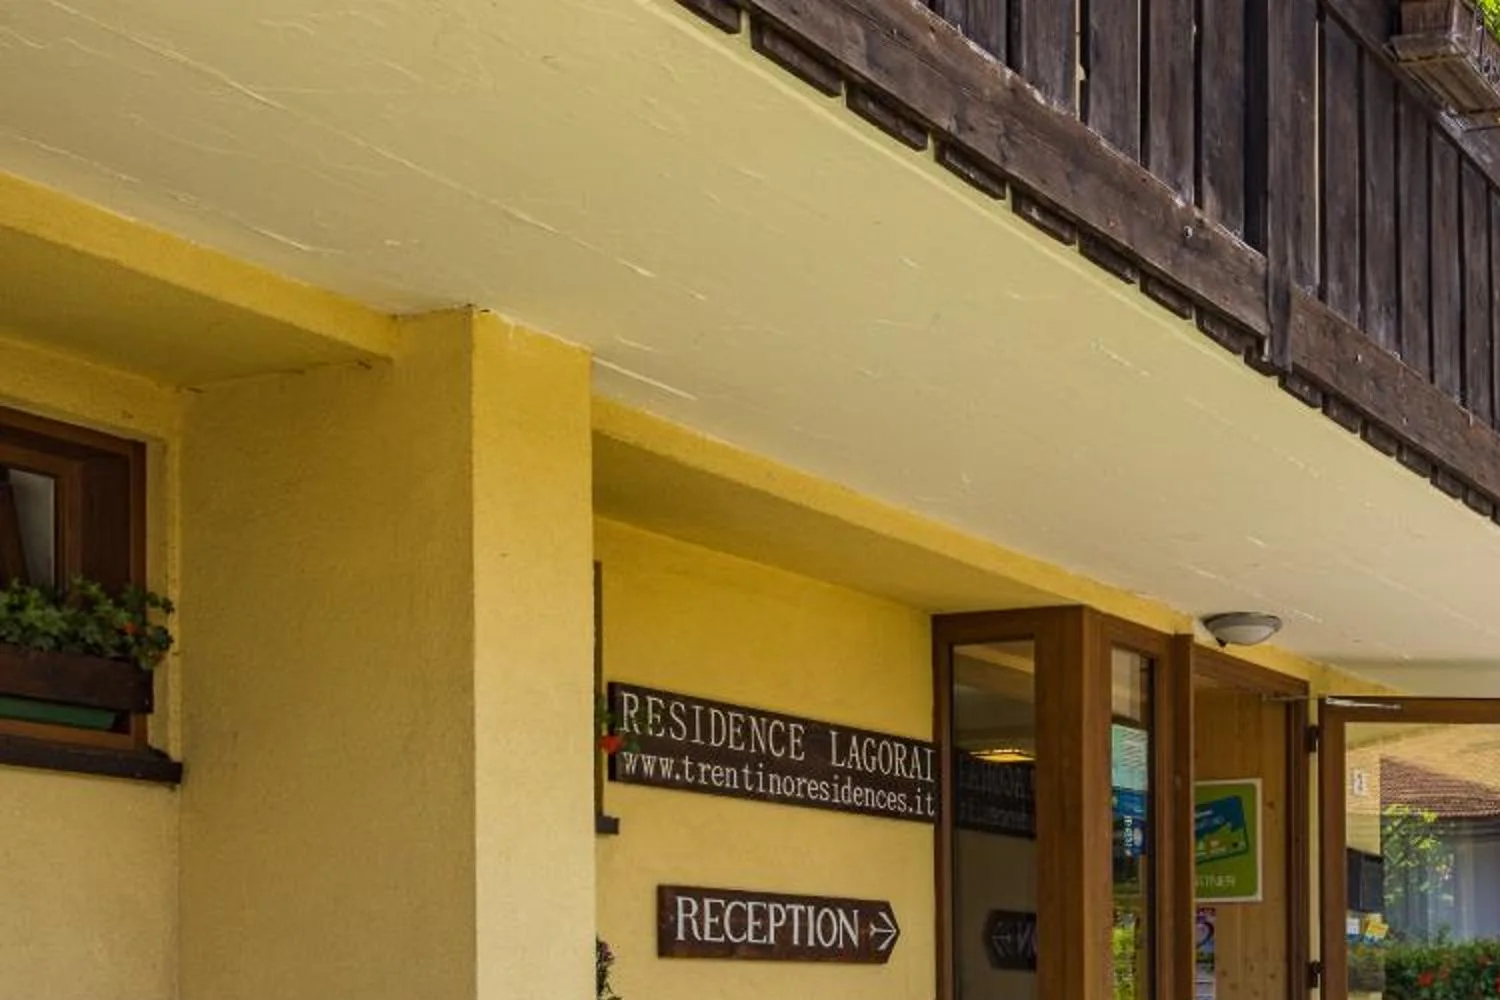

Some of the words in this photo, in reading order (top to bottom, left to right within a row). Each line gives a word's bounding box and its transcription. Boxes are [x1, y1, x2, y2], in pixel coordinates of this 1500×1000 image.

[616, 692, 805, 761] RESIDENCE
[829, 730, 936, 783] LAGORAI
[621, 751, 936, 817] www.trentinoresidences.it
[675, 894, 860, 948] RECEPTION
